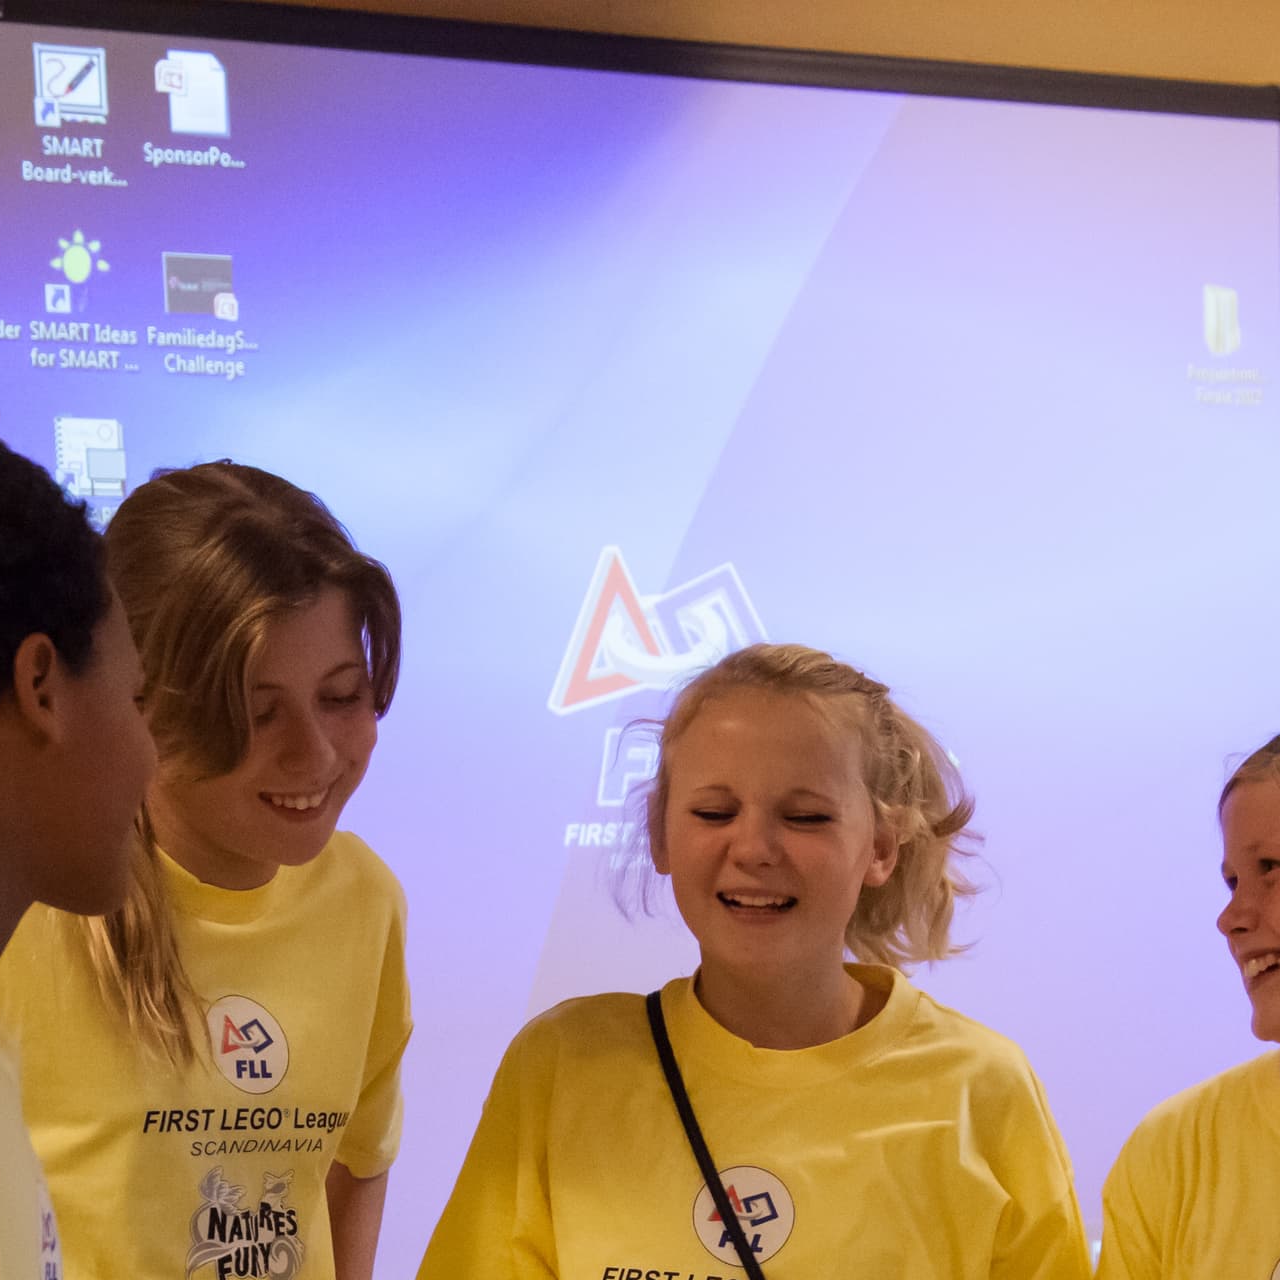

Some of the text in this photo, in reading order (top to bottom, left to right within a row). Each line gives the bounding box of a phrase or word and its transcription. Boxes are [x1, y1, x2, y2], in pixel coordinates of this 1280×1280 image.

[42, 136, 104, 158] SMART
[30, 321, 138, 345] SMART Ideas
[30, 349, 55, 368] for
[60, 350, 120, 370] SMART
[164, 355, 246, 379] Challenge
[236, 1059, 272, 1079] FLL
[143, 1109, 215, 1133] FIRST
[190, 1138, 323, 1157] SCANDINAVIA
